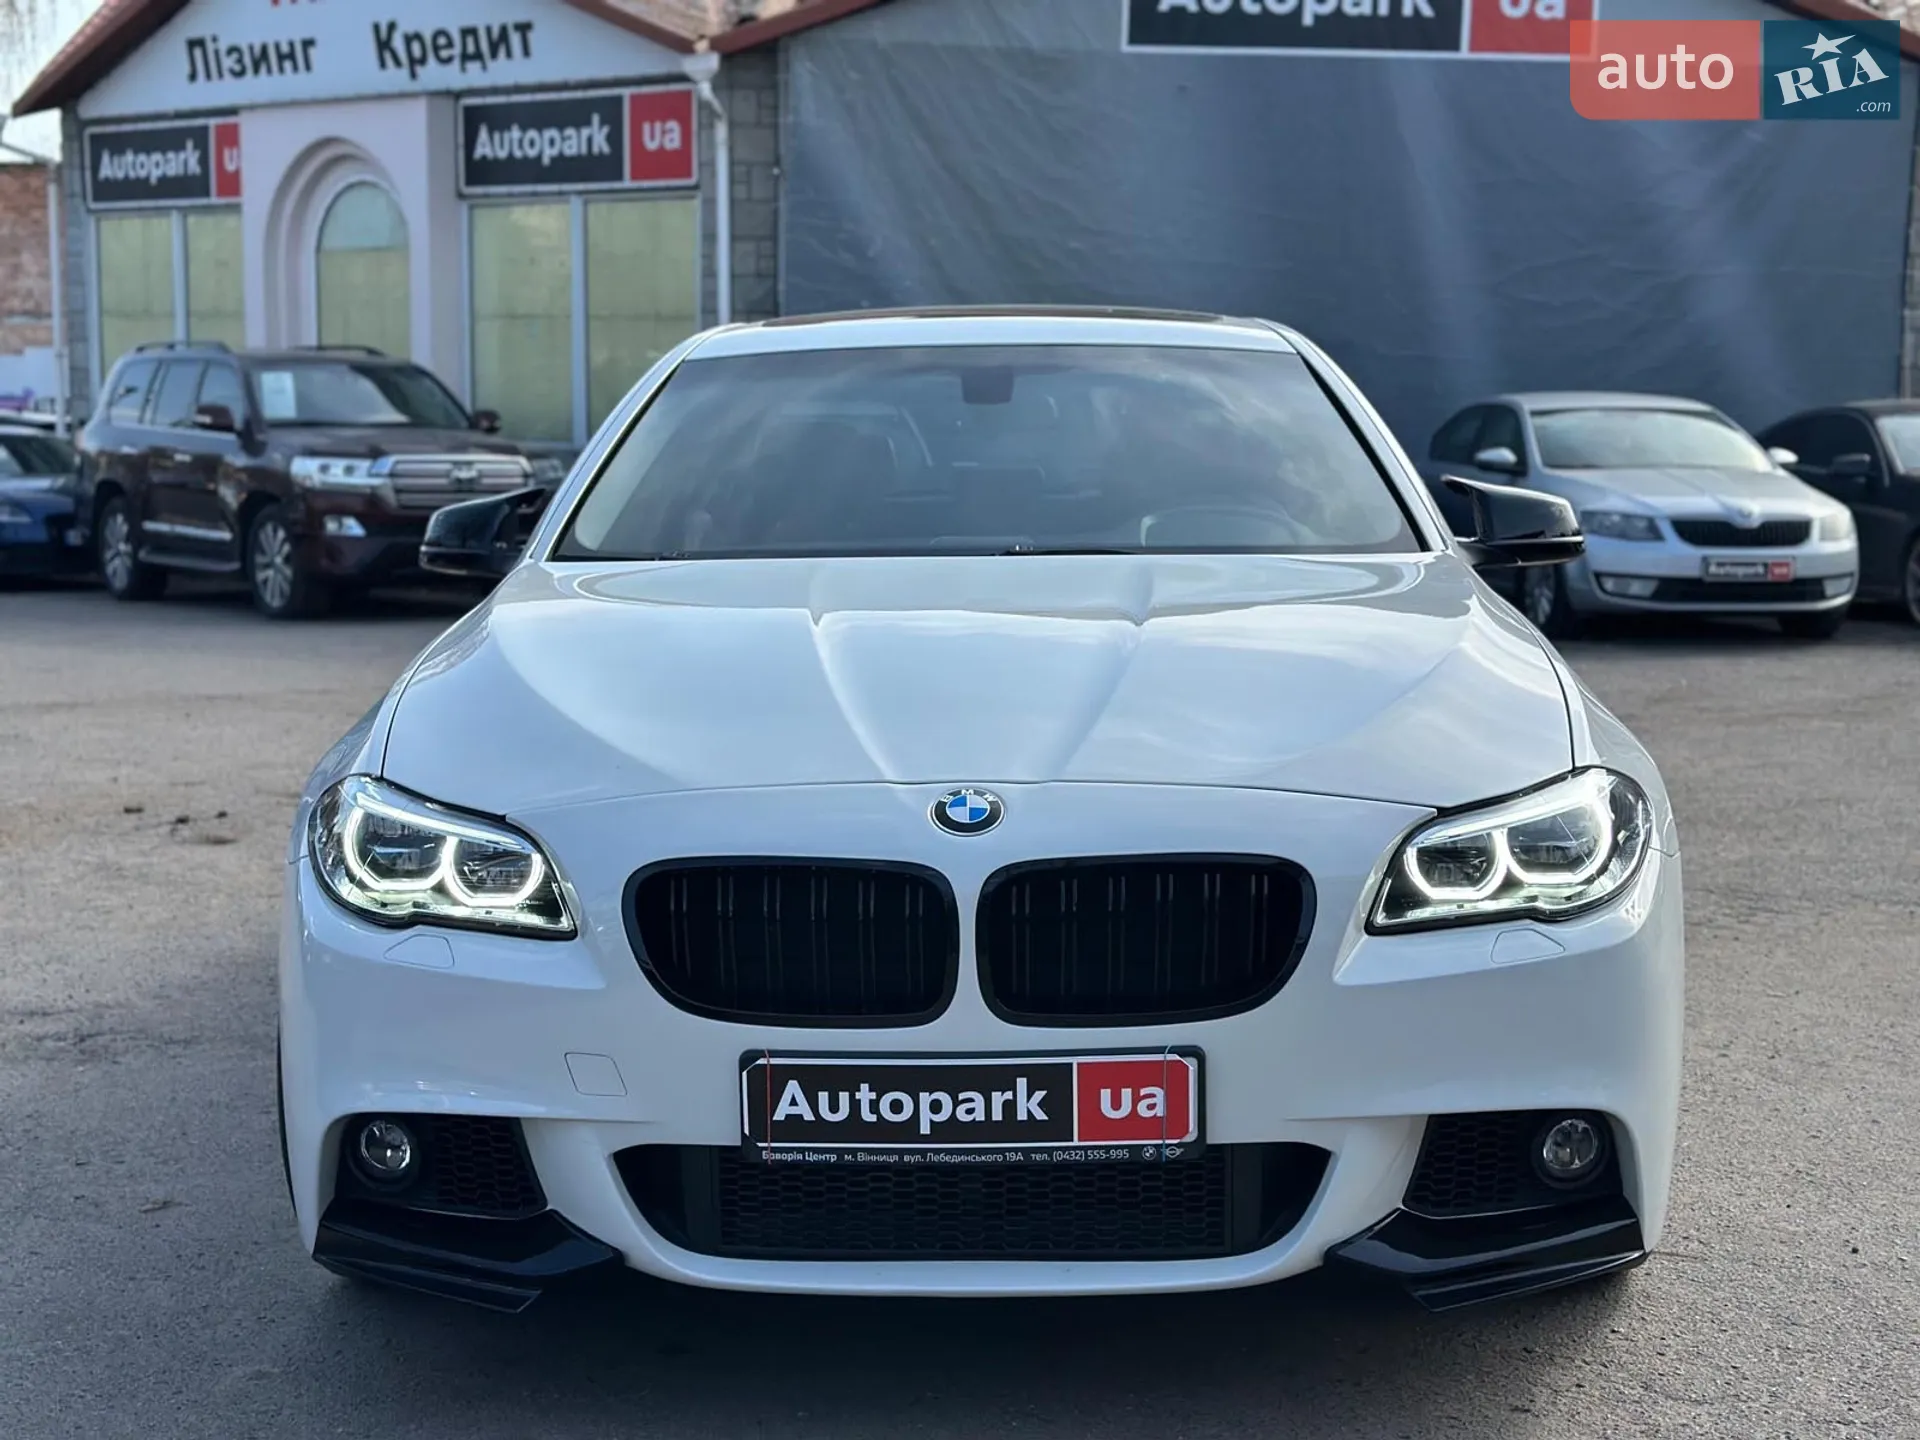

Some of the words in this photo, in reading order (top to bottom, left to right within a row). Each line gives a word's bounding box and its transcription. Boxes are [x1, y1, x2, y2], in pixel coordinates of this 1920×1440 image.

[185, 34, 317, 83] Лізинг
[372, 20, 534, 81] Кредит
[97, 137, 202, 186] Autopark
[222, 146, 240, 173] u
[472, 111, 611, 167] Autopark
[641, 119, 682, 151] ua
[940, 788, 998, 803] BMW
[773, 1077, 1049, 1134] Autopark
[1100, 1086, 1165, 1119] ua
[805, 1151, 837, 1162] Центр
[857, 1152, 899, 1163] Вінниця
[903, 1154, 924, 1164] вул.
[926, 1152, 1003, 1163] Лебединського
[1030, 1153, 1050, 1161] тел.
[1053, 1150, 1085, 1162] (0432)
[1087, 1148, 1130, 1160] 555-995
